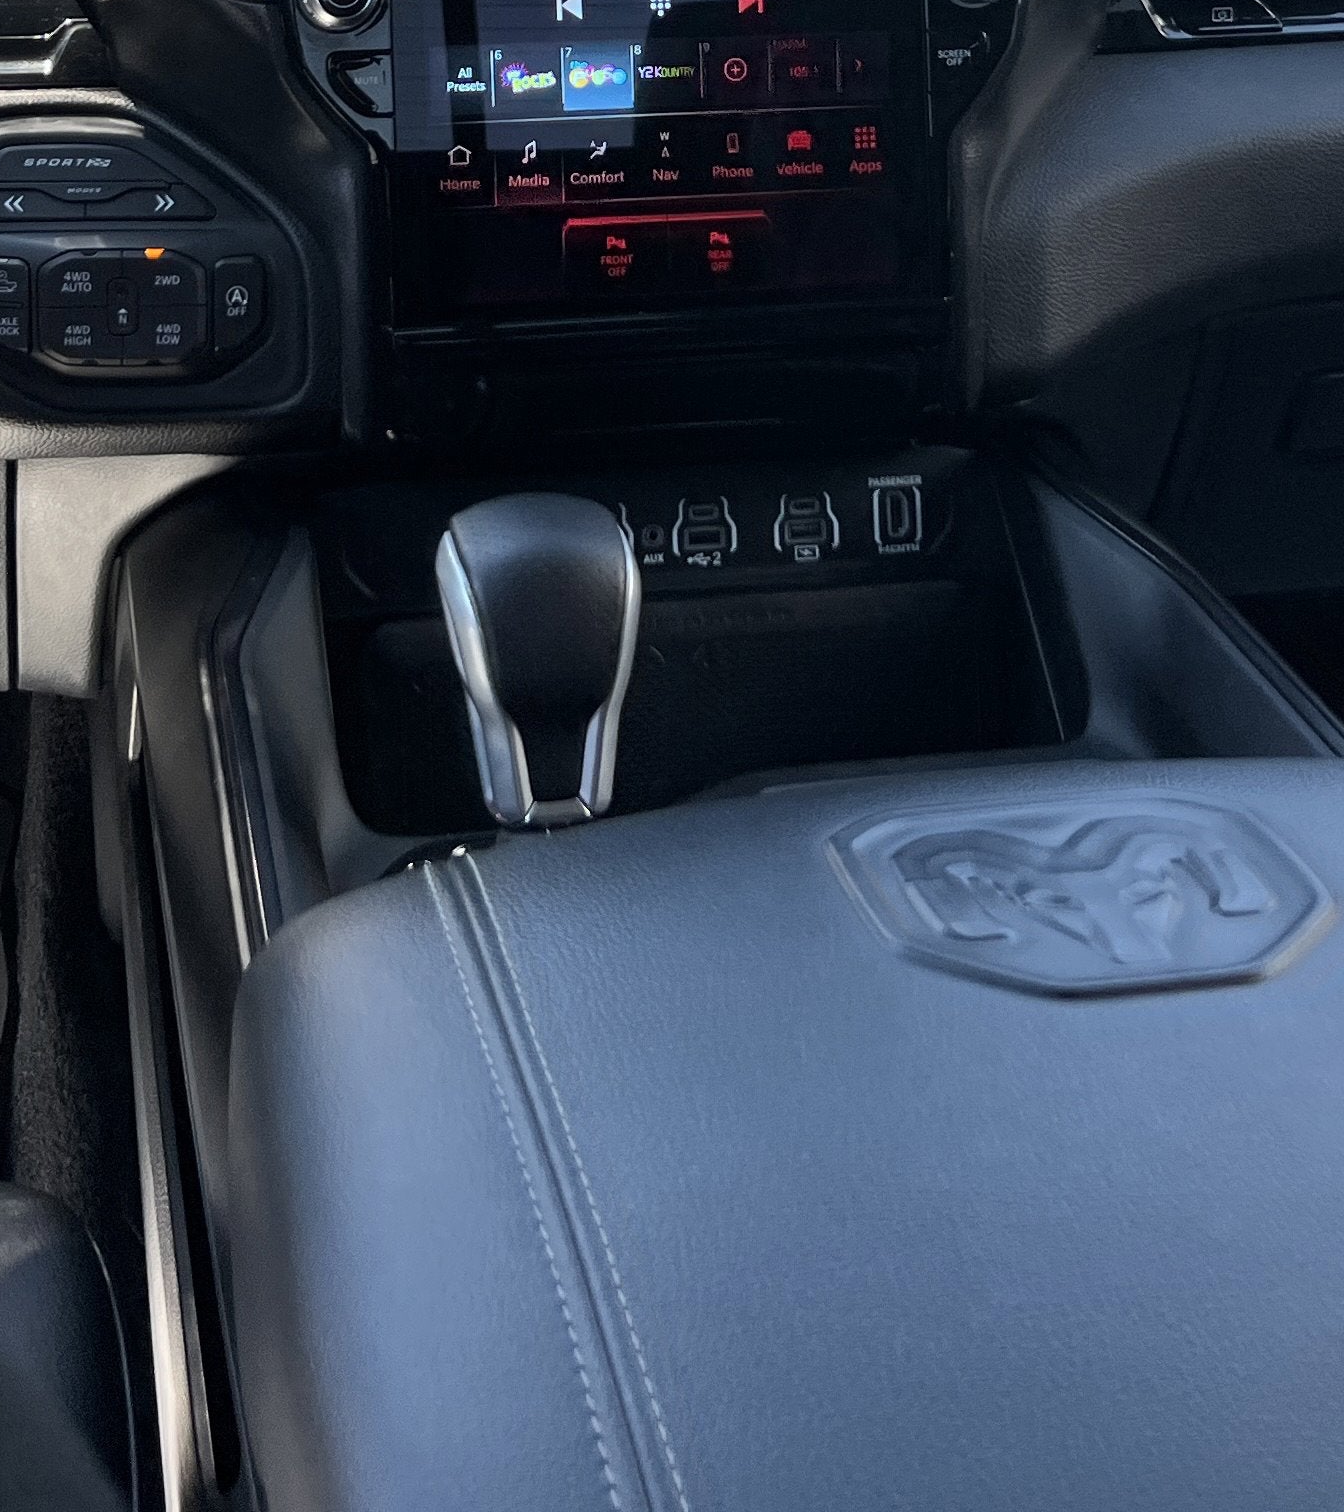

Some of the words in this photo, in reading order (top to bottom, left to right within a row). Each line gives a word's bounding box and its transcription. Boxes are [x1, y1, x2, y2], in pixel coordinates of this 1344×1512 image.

[494, 49, 503, 61] 6
[565, 47, 573, 58] 7
[633, 44, 642, 55] 8
[937, 49, 971, 59] SCREEN
[946, 58, 963, 67] OFF
[457, 67, 473, 79] All
[354, 76, 379, 86] MUTE
[446, 80, 487, 93] Presets
[23, 157, 85, 167] SPORT
[849, 159, 883, 174] Apps
[652, 168, 679, 181] Nav
[712, 165, 754, 178] Phone
[776, 162, 824, 176] Vehicle
[508, 174, 550, 187] Media
[570, 170, 625, 185] Comfort
[440, 179, 481, 191] Home
[600, 254, 634, 265] FRONT
[708, 250, 733, 259] REAR
[607, 267, 627, 277] OFF
[711, 262, 730, 272] OFF
[63, 271, 90, 282] 4WD
[154, 275, 180, 286] 2WD
[61, 282, 92, 293] AUTO
[227, 306, 247, 317] OFF
[65, 325, 90, 336] 4WD
[156, 324, 181, 334] 4WD
[64, 336, 92, 347] HIGH
[156, 334, 180, 345] LOW
[868, 474, 923, 487] PASSENGER
[644, 553, 665, 564] AUX
[711, 551, 722, 566] 2
